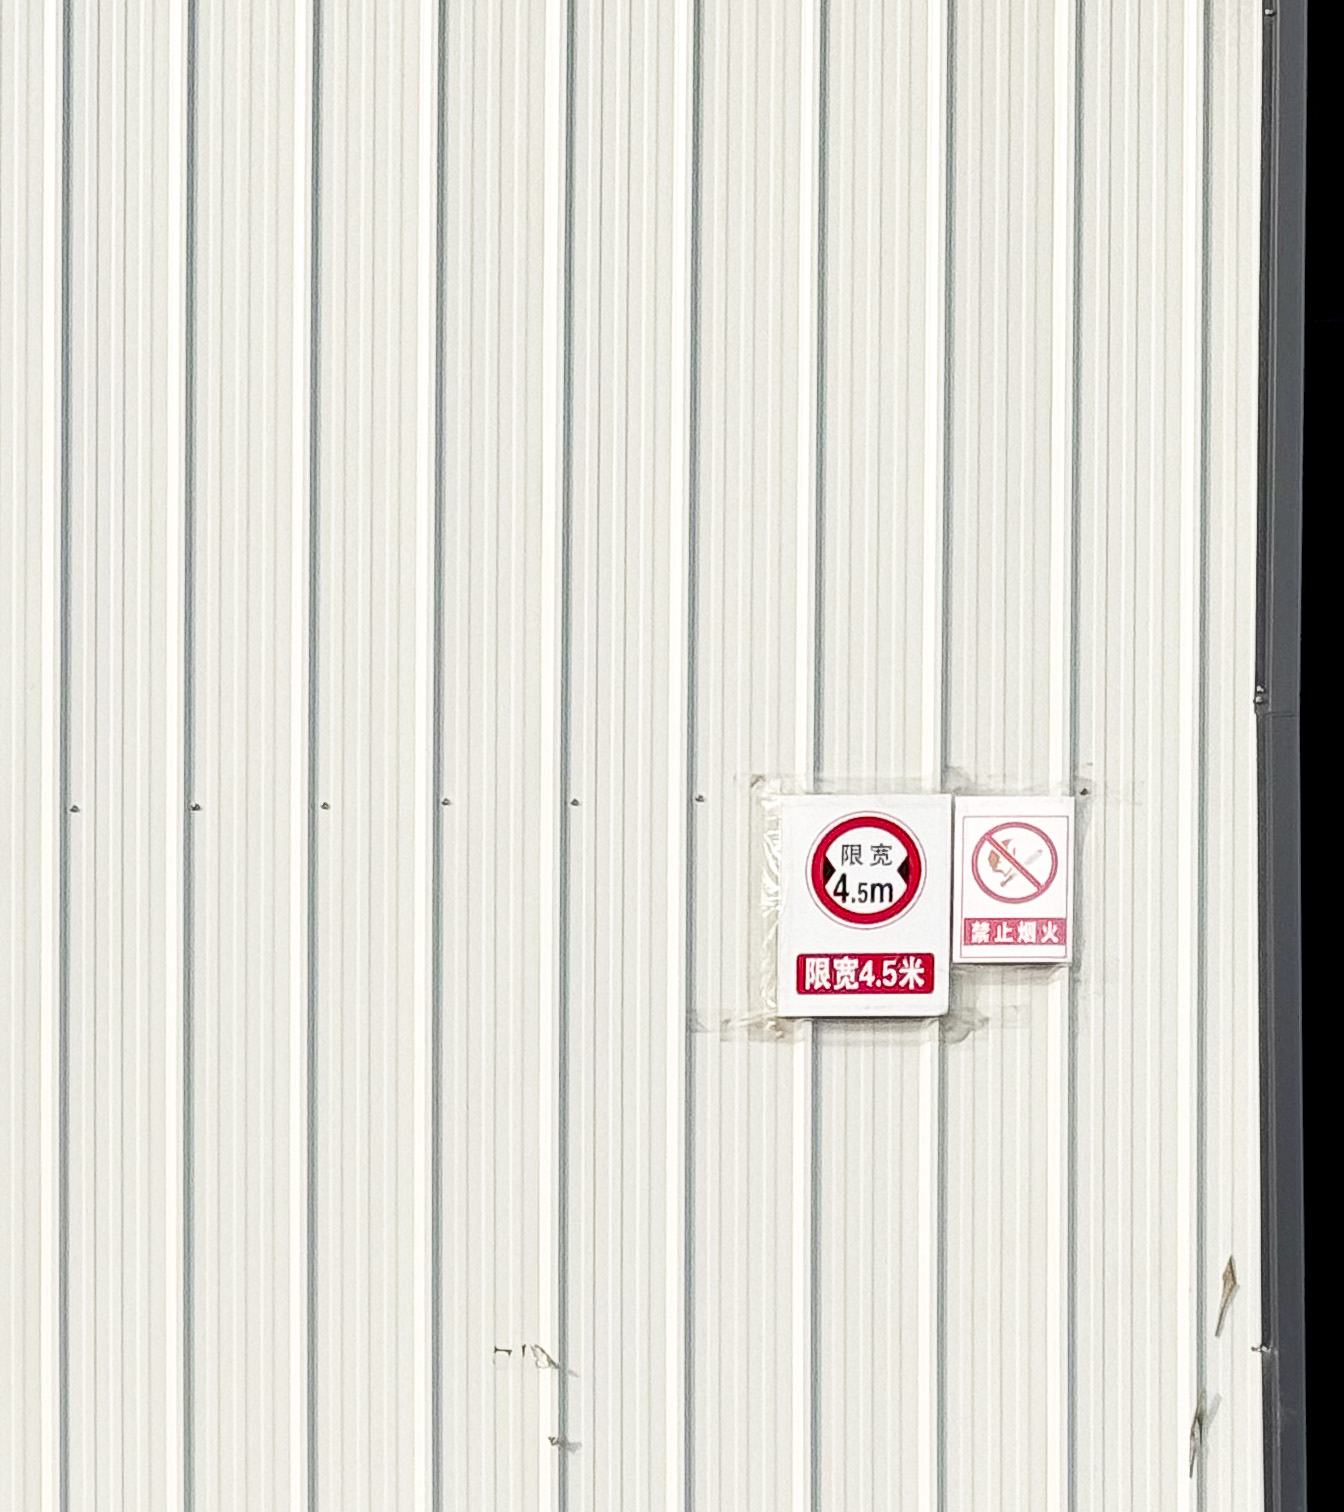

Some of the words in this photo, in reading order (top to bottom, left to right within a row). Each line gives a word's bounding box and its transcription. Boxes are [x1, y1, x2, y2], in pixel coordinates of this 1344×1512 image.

[841, 843, 893, 867] 限宽
[833, 872, 894, 904] 4.5m
[970, 921, 1060, 944] 禁止烟火
[804, 956, 925, 991] 限宽4.5米
